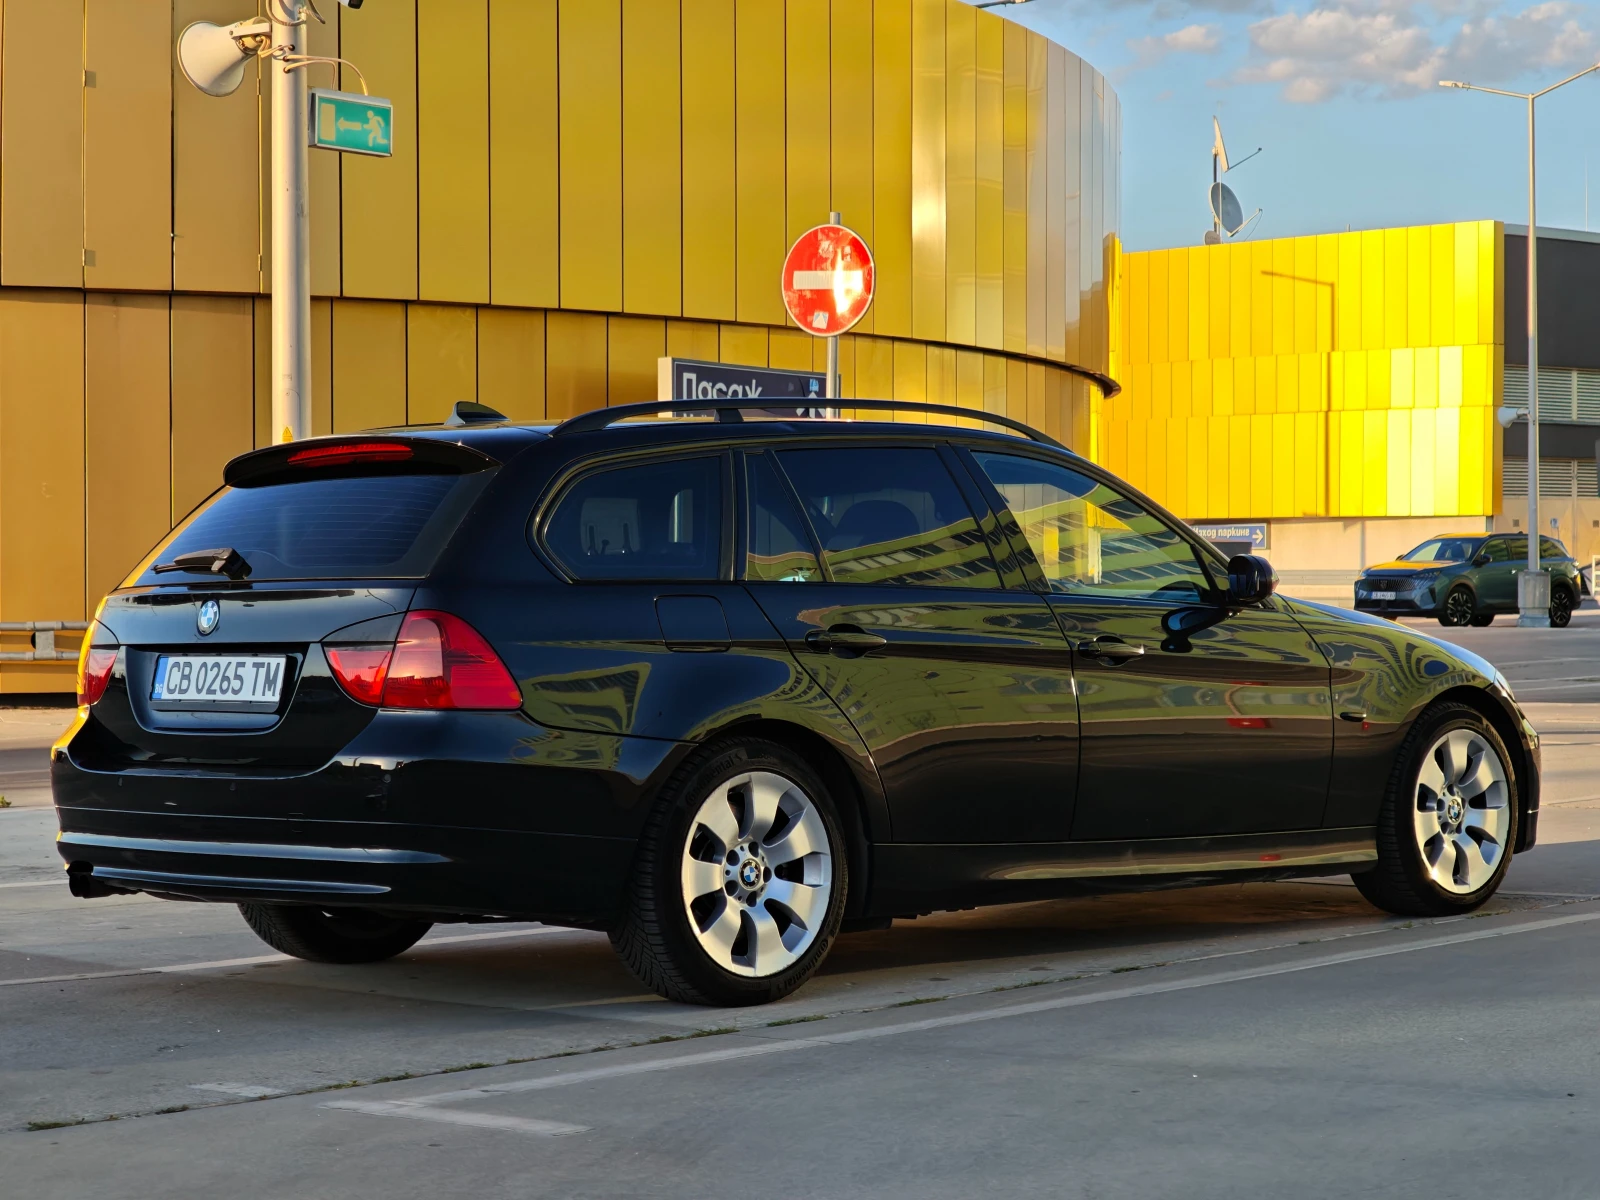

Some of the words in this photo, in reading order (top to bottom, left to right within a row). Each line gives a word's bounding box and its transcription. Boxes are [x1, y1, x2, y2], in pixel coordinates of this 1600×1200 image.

[683, 372, 762, 399] Пасаж
[154, 683, 163, 694] BG
[167, 662, 192, 694] CB
[195, 662, 246, 695] 0265
[251, 661, 281, 697] TM
